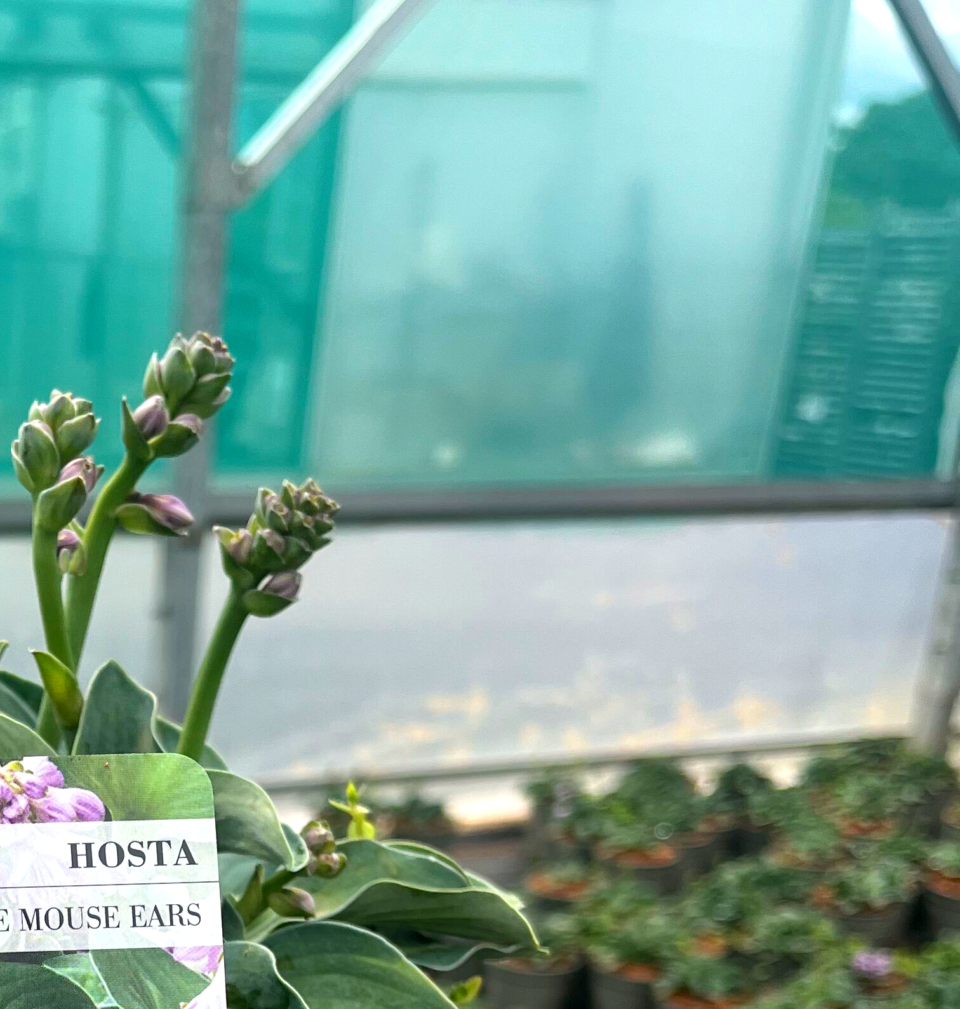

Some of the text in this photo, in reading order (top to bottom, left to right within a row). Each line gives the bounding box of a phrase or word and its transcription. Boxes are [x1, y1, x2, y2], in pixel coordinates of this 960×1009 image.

[67, 839, 198, 869] HOSTA
[18, 905, 121, 932] MOUSE
[129, 902, 202, 928] EARS
